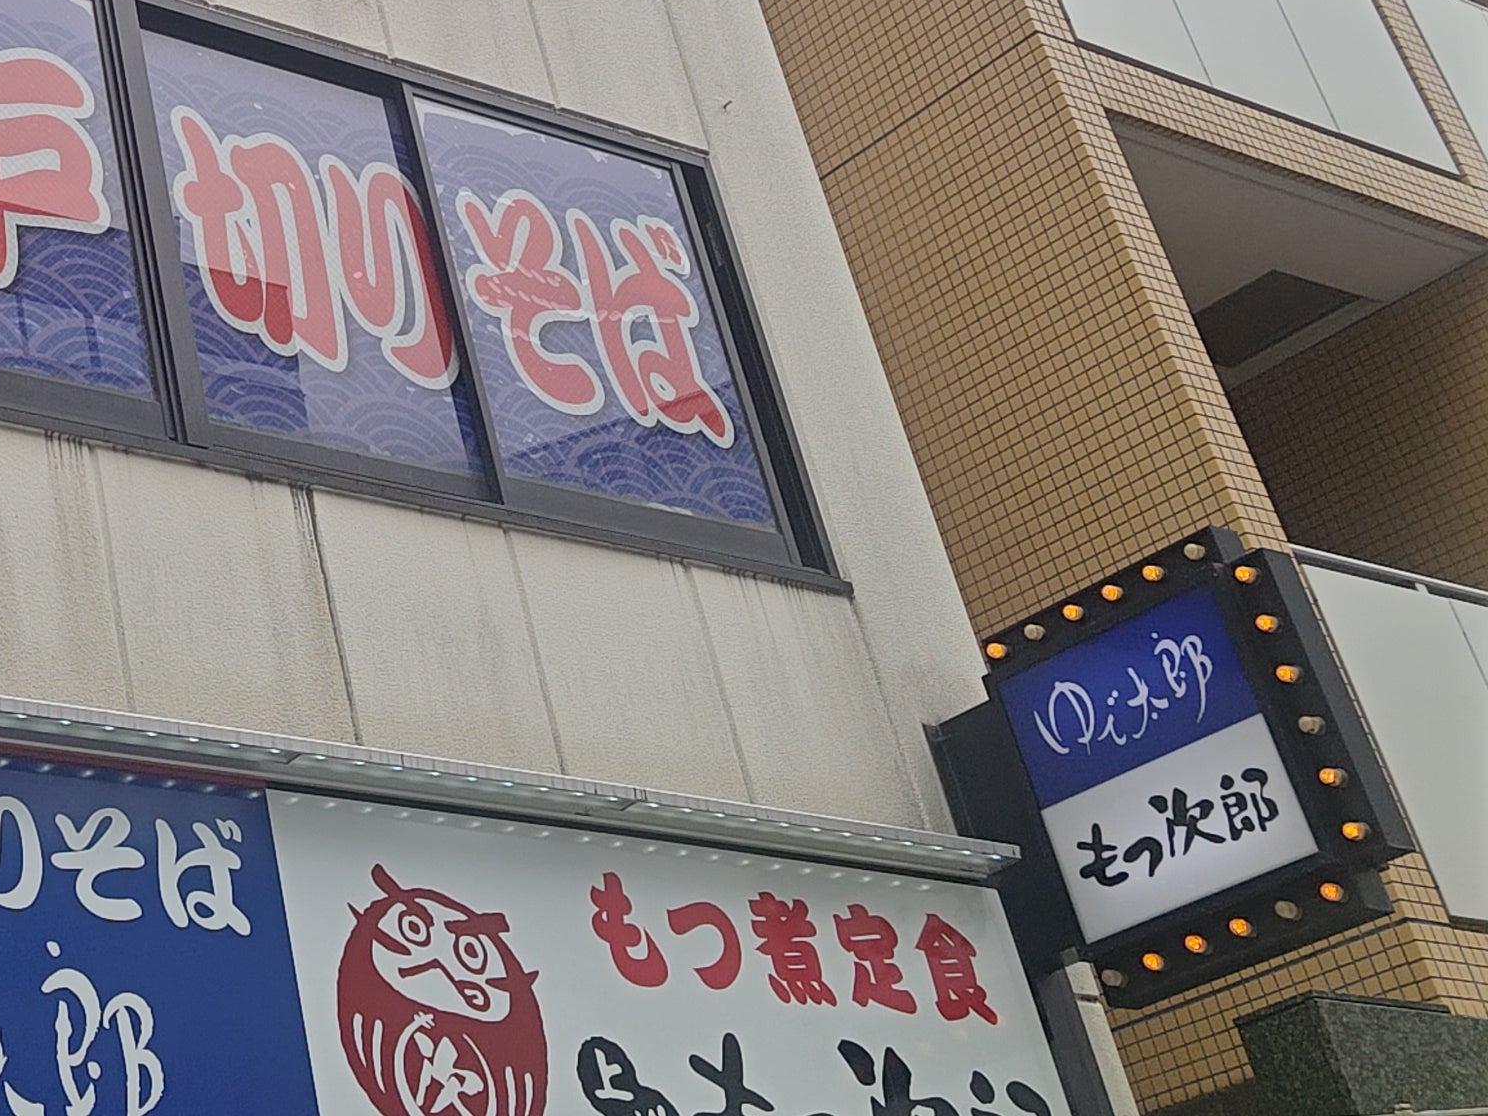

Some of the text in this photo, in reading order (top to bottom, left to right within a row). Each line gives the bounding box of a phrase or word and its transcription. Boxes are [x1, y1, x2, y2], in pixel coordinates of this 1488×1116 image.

[1034, 631, 1213, 756] ゆで太郎
[1076, 768, 1280, 886] もつ次郎
[590, 872, 999, 1025] もつ煮定食
